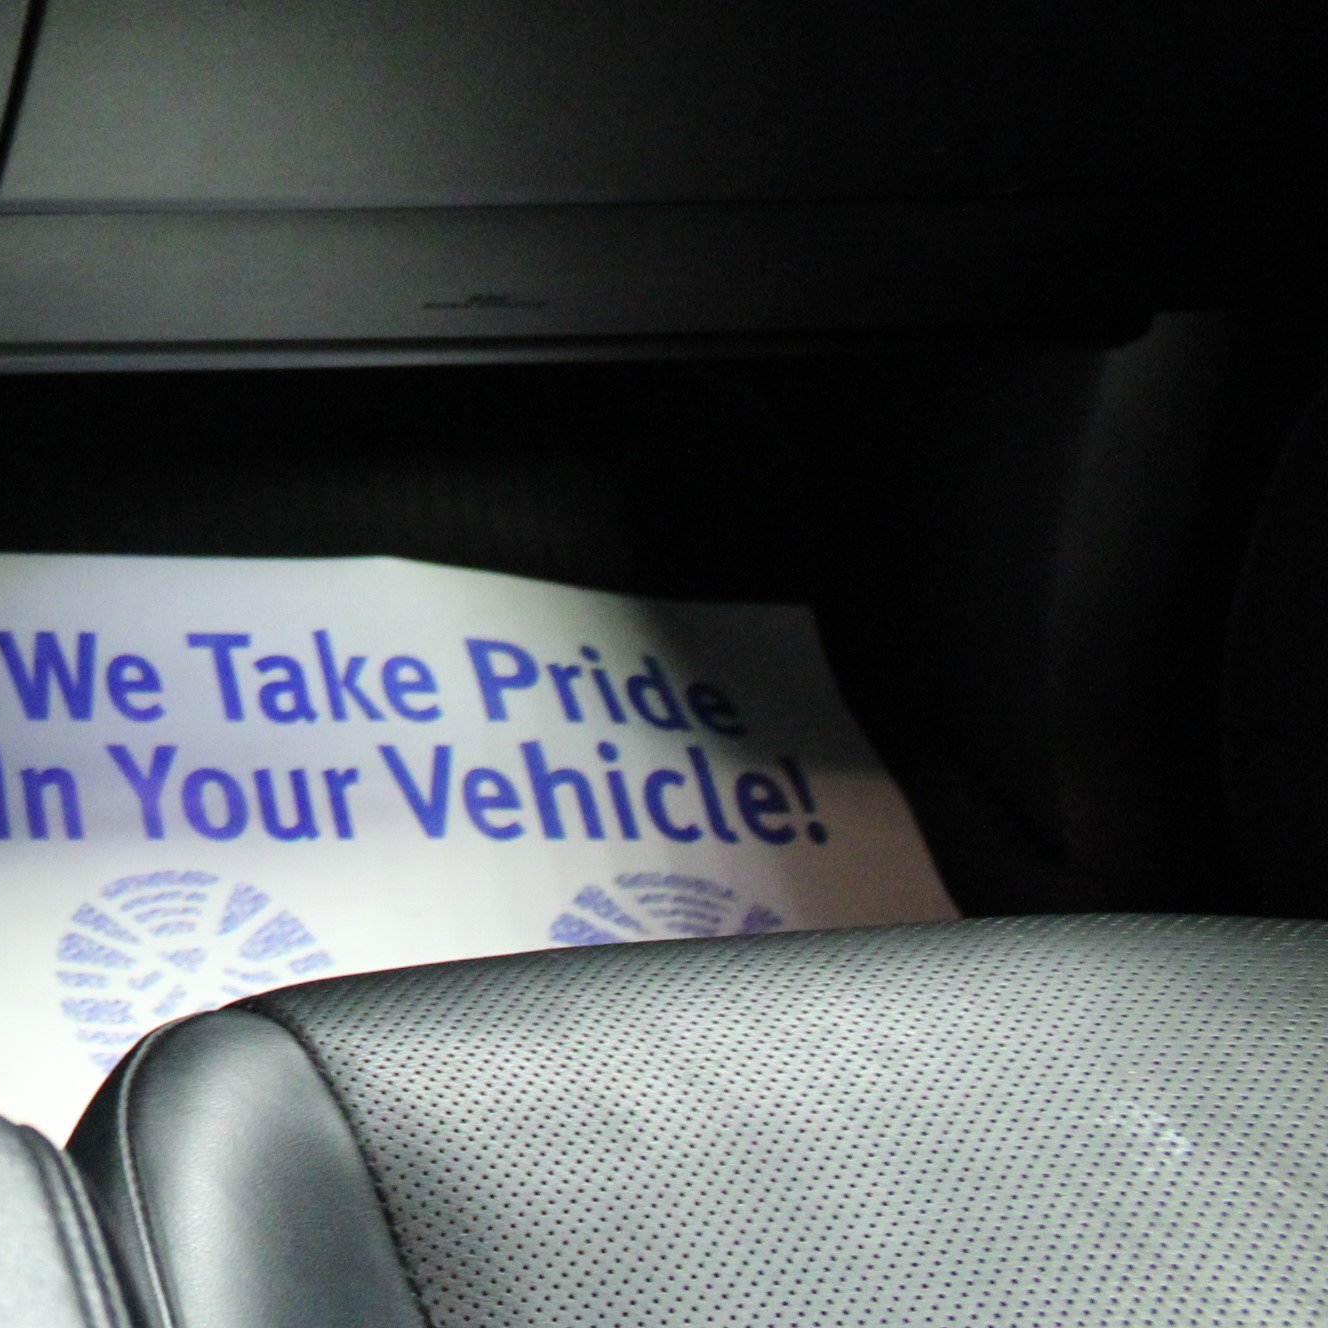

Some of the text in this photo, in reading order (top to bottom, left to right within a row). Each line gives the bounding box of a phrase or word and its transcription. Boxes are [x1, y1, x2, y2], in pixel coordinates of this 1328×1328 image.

[186, 629, 443, 725] Take
[465, 637, 746, 739] Pride
[105, 743, 360, 843] Your
[377, 739, 830, 847] Vehicle!
